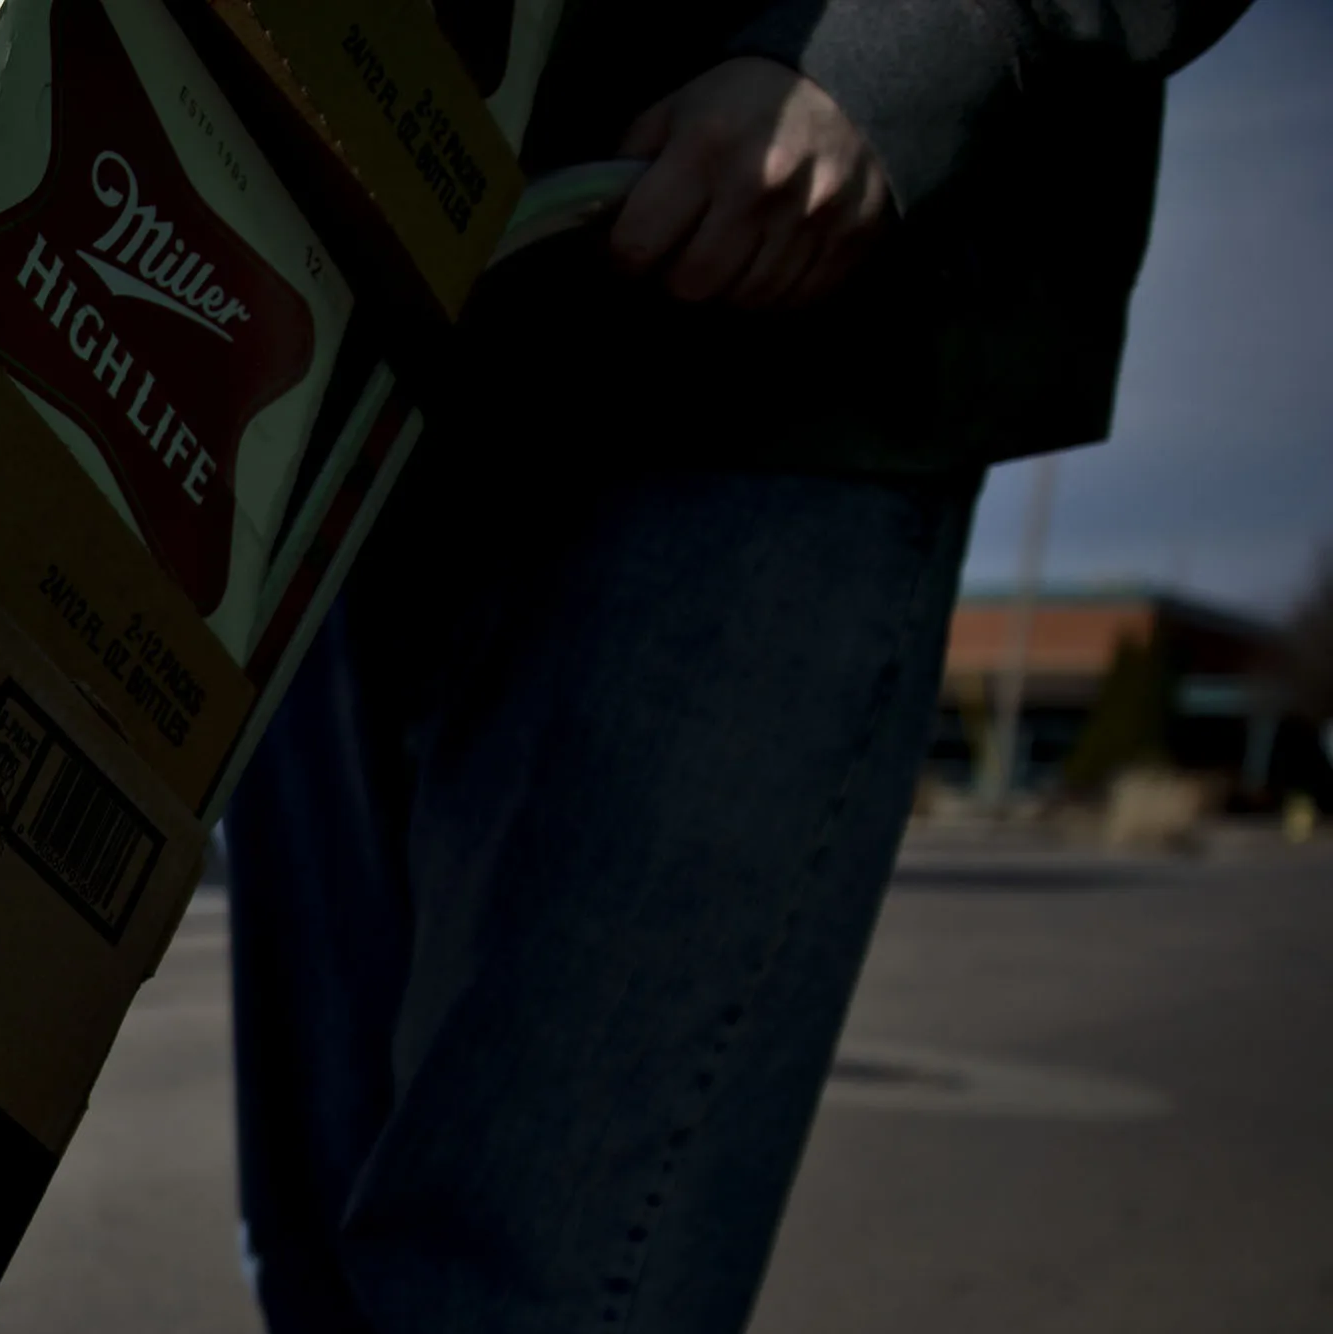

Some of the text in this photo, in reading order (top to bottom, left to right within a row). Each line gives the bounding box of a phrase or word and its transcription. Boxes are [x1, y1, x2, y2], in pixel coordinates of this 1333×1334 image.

[90, 149, 252, 328] Miller
[305, 246, 324, 279] 12
[15, 231, 218, 505] HIGH LIFE
